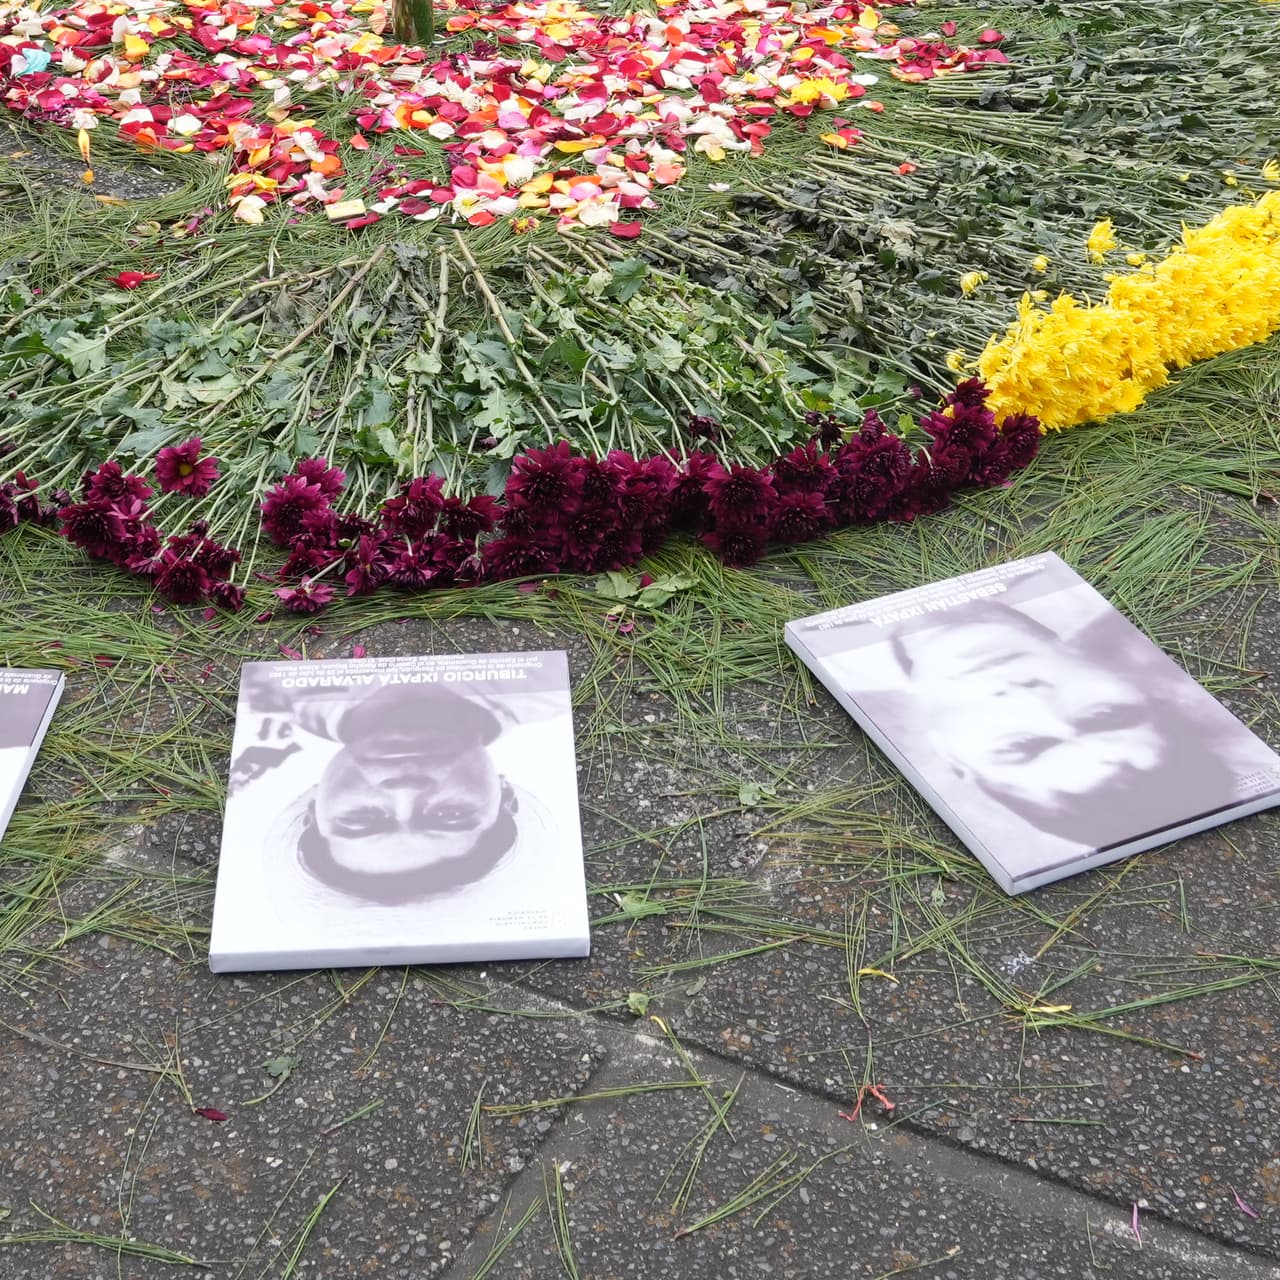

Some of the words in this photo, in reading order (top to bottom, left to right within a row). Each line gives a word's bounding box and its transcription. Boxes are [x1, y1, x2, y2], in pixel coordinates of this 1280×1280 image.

[282, 674, 374, 688] ALVARADO
[378, 671, 437, 686] IXPATÁ
[443, 668, 526, 681] TIBURCIO
